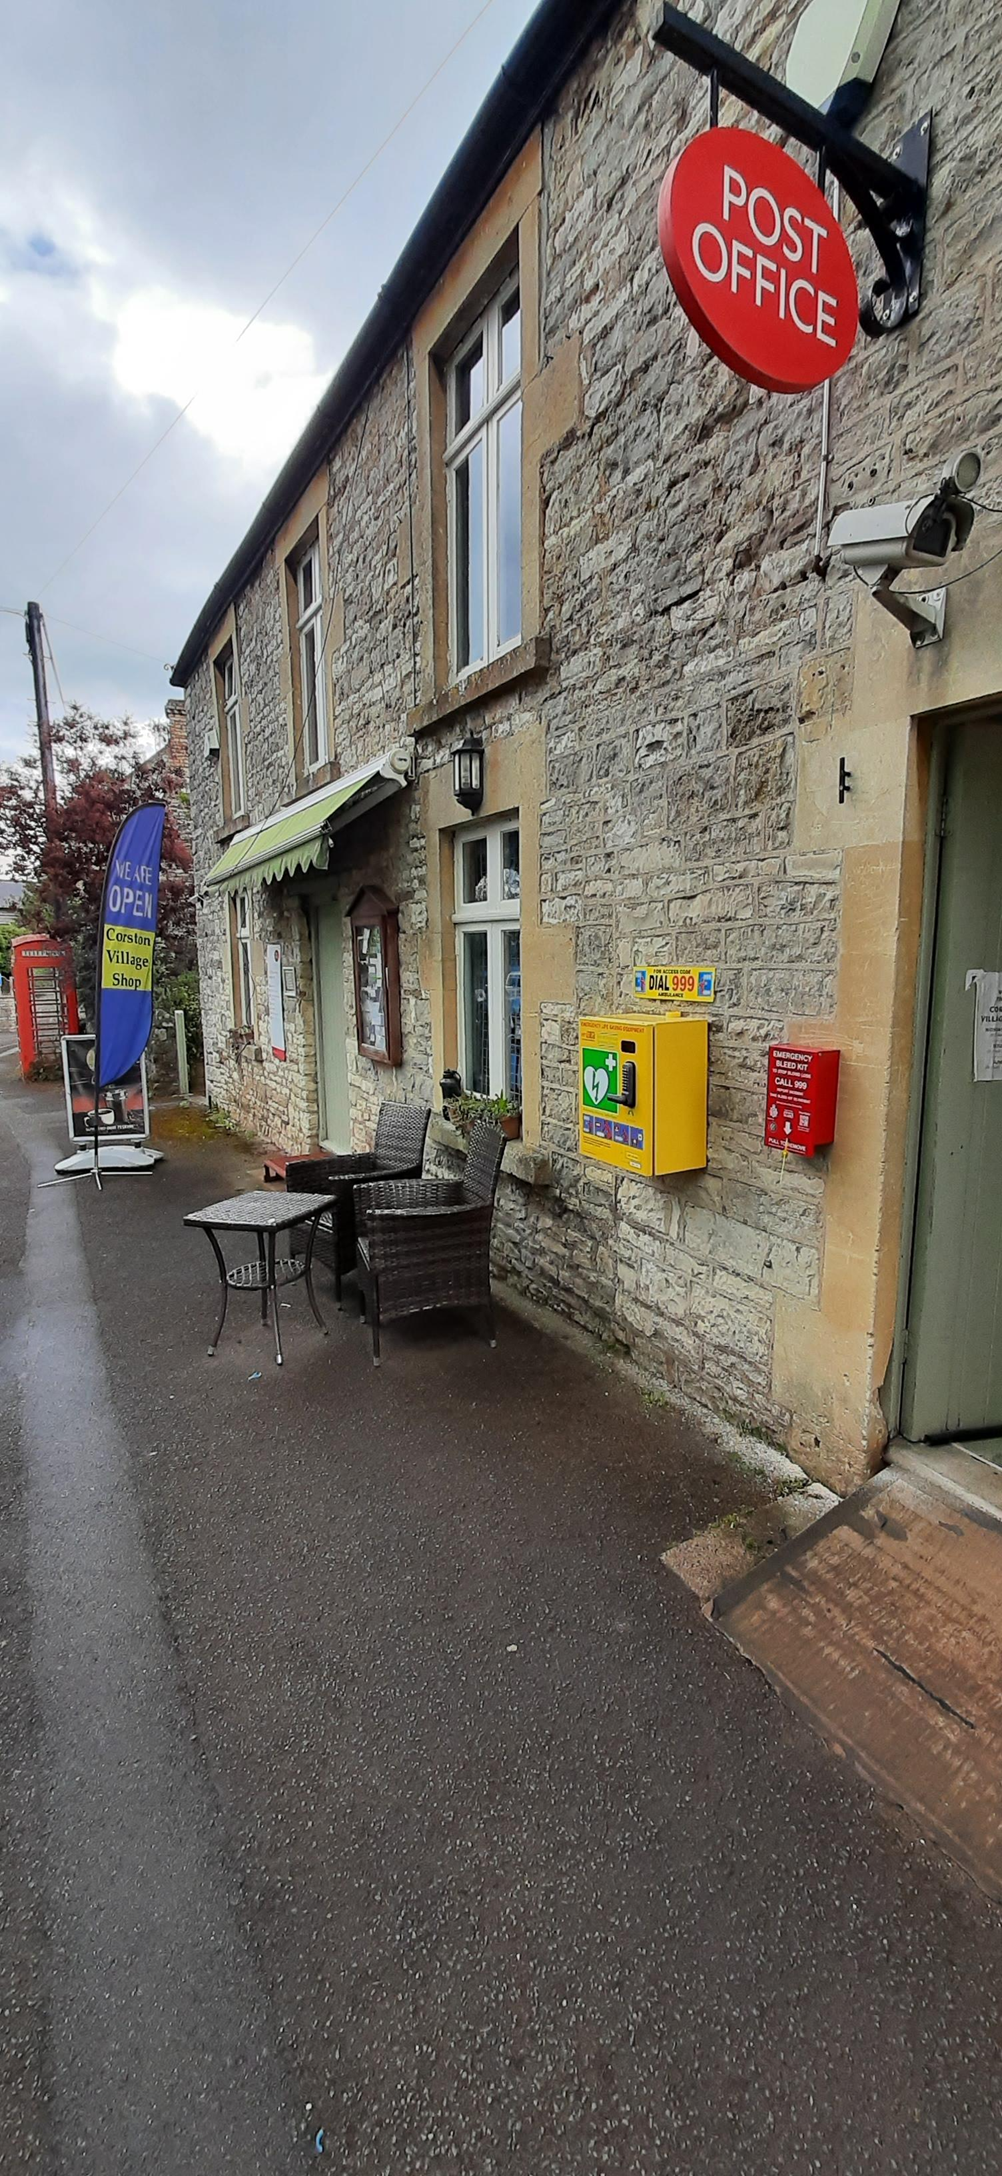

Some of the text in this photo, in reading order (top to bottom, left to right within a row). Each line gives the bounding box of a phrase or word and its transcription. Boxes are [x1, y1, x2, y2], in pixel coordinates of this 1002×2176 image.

[723, 164, 828, 274] POST
[692, 222, 837, 348] OFFICE
[115, 860, 153, 886] WE ARE
[108, 885, 153, 919] OPEN
[106, 927, 151, 947] Corston
[106, 949, 149, 970] Village
[112, 972, 142, 991] Shop
[649, 975, 695, 992] DIAL 999
[773, 1050, 813, 1063] EMERGENCY
[775, 1059, 809, 1071] BLEED KIT
[775, 1077, 808, 1090] CALL 999
[769, 1137, 779, 1145] PULL
